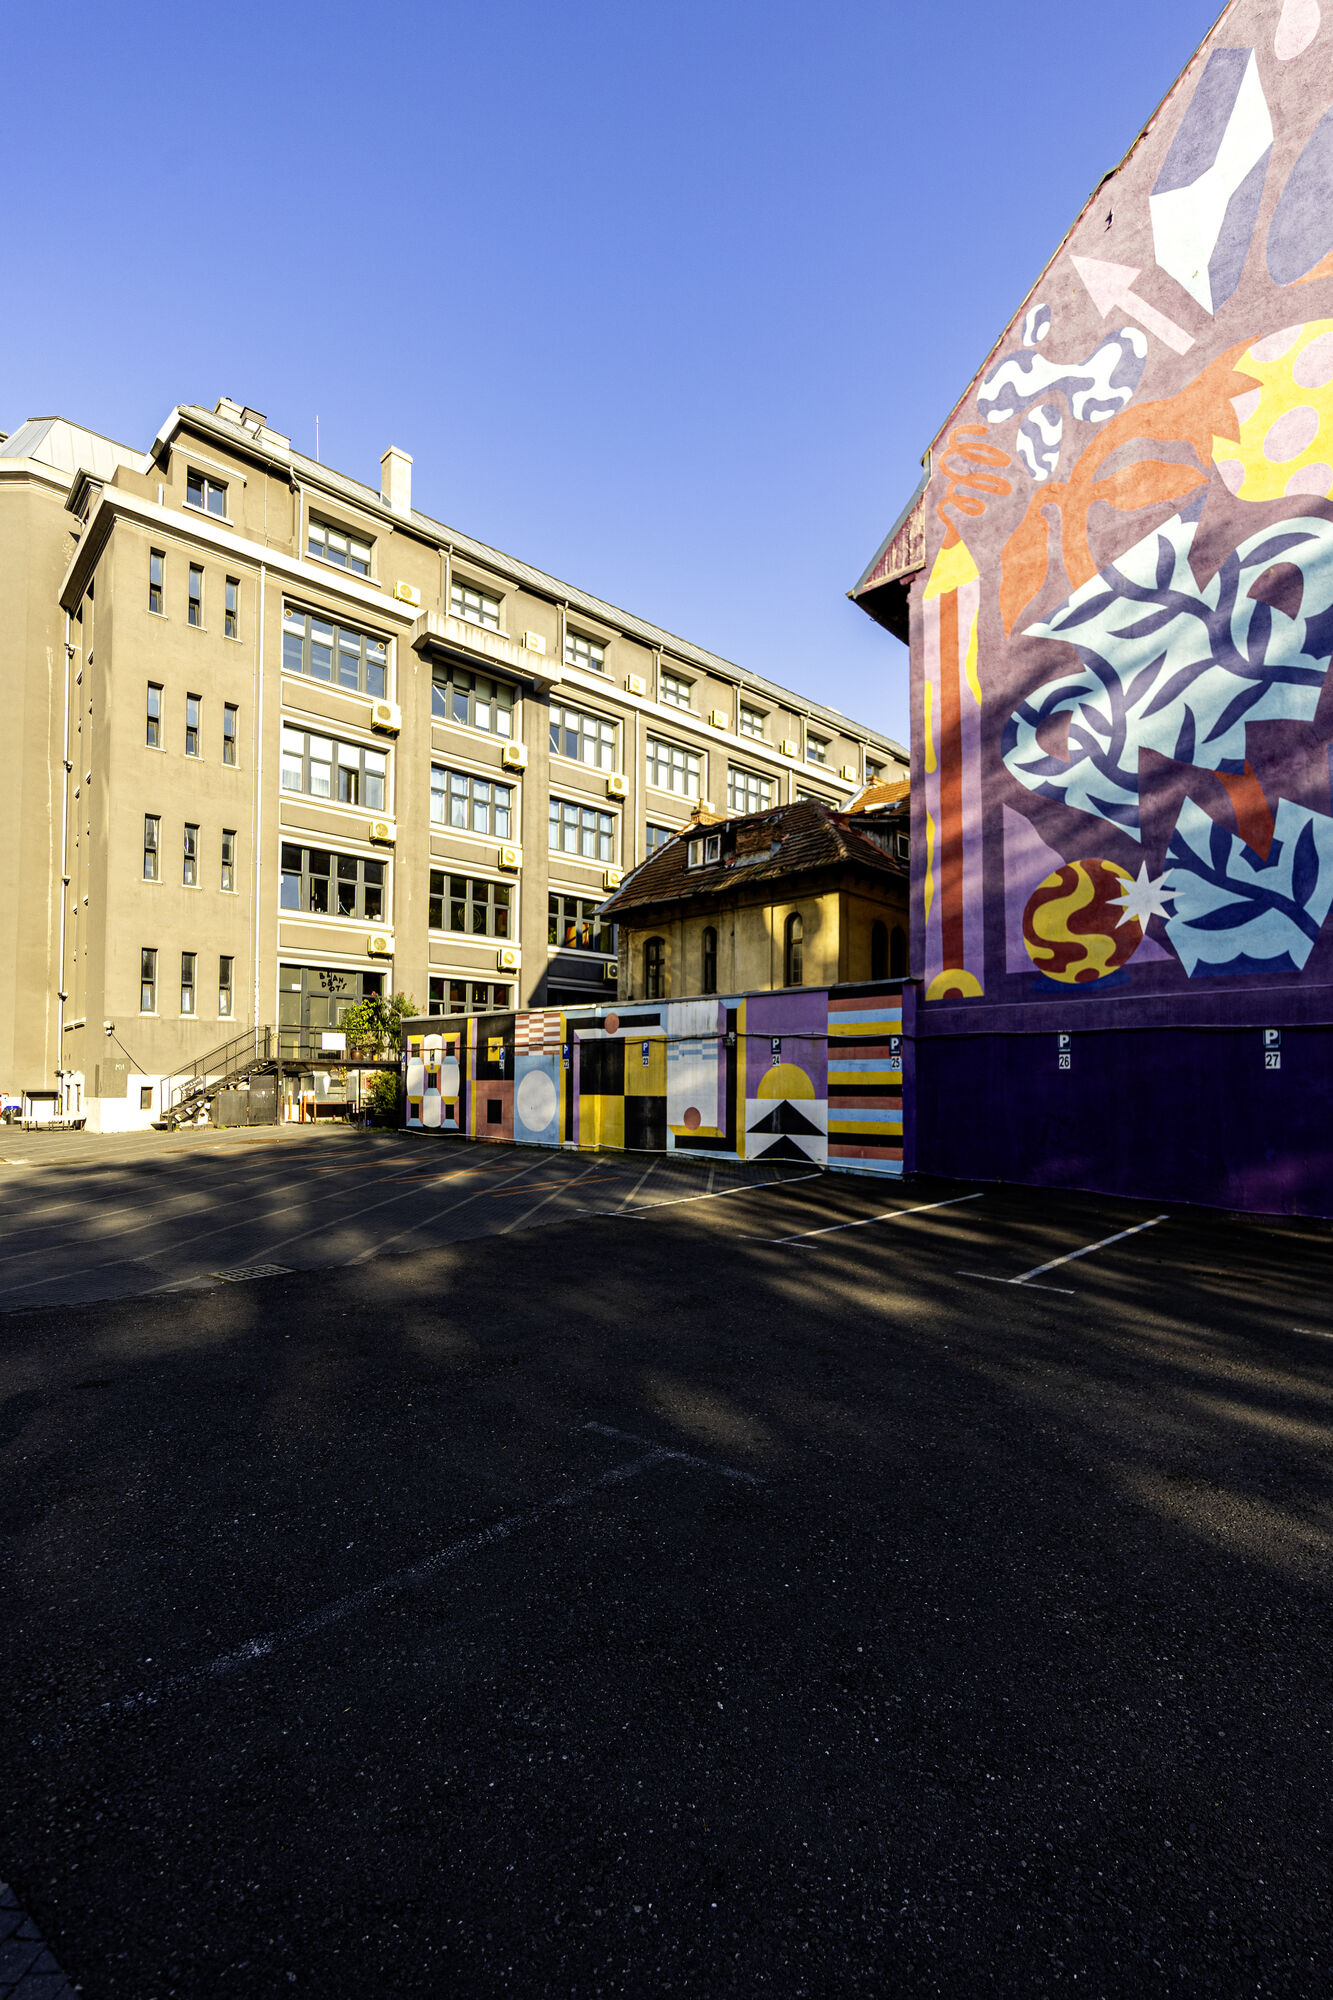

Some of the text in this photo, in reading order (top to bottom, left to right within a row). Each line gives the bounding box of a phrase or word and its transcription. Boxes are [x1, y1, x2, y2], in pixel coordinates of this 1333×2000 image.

[1059, 1034, 1070, 1048] P
[1265, 1029, 1279, 1044] P
[642, 1042, 648, 1051] P
[772, 1038, 780, 1049] P
[891, 1037, 899, 1050] P
[891, 1057, 900, 1068] 25
[1059, 1055, 1070, 1068] 26
[1265, 1054, 1279, 1067] 27
